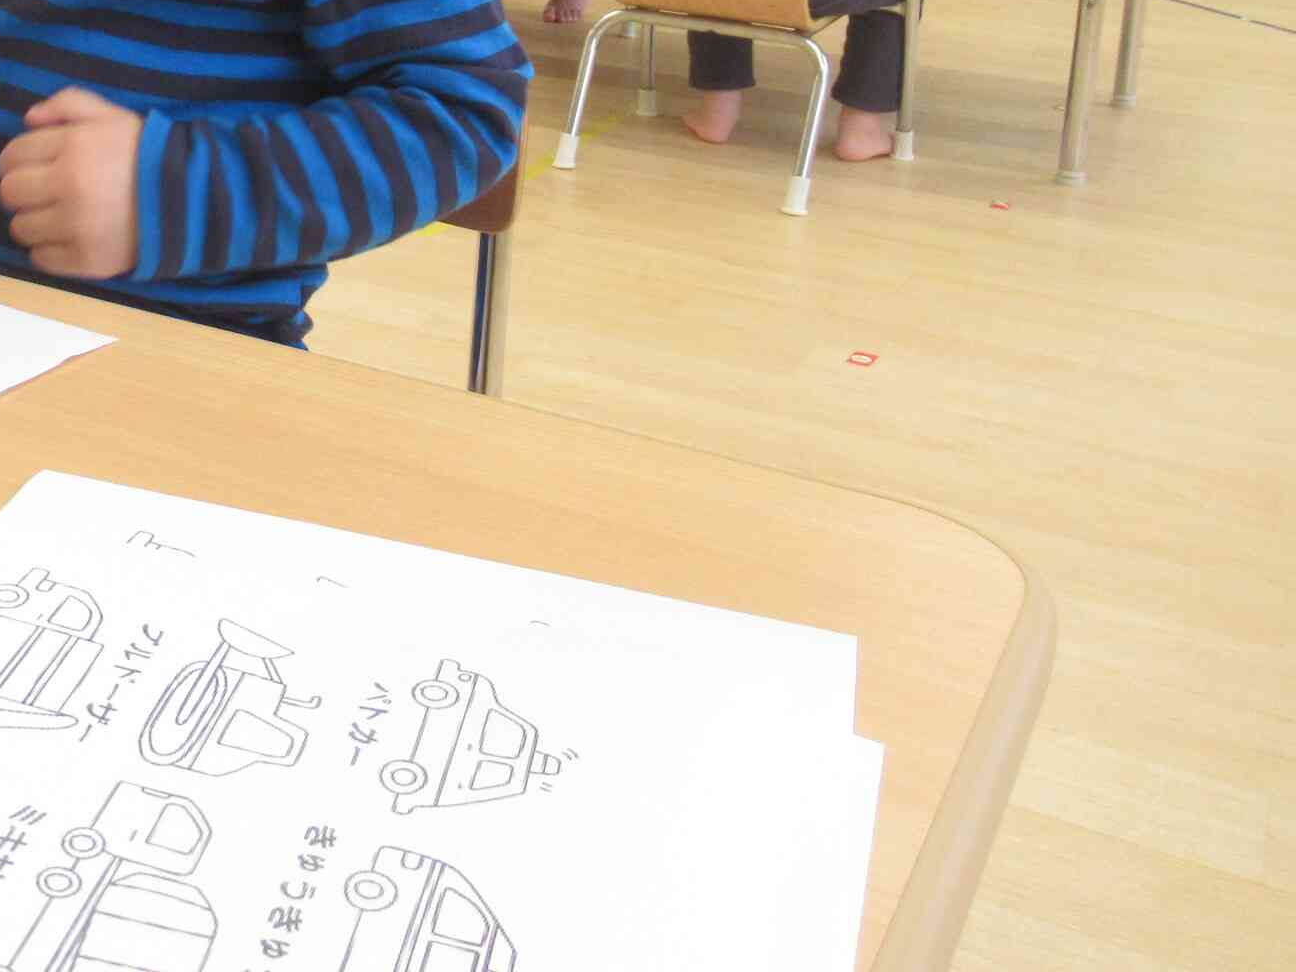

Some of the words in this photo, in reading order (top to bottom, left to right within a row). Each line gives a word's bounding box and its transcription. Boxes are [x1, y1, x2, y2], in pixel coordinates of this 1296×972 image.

[78, 623, 165, 743] ブルドーザー
[348, 682, 392, 768] パトカー
[242, 825, 338, 972] きゅうきゅ
